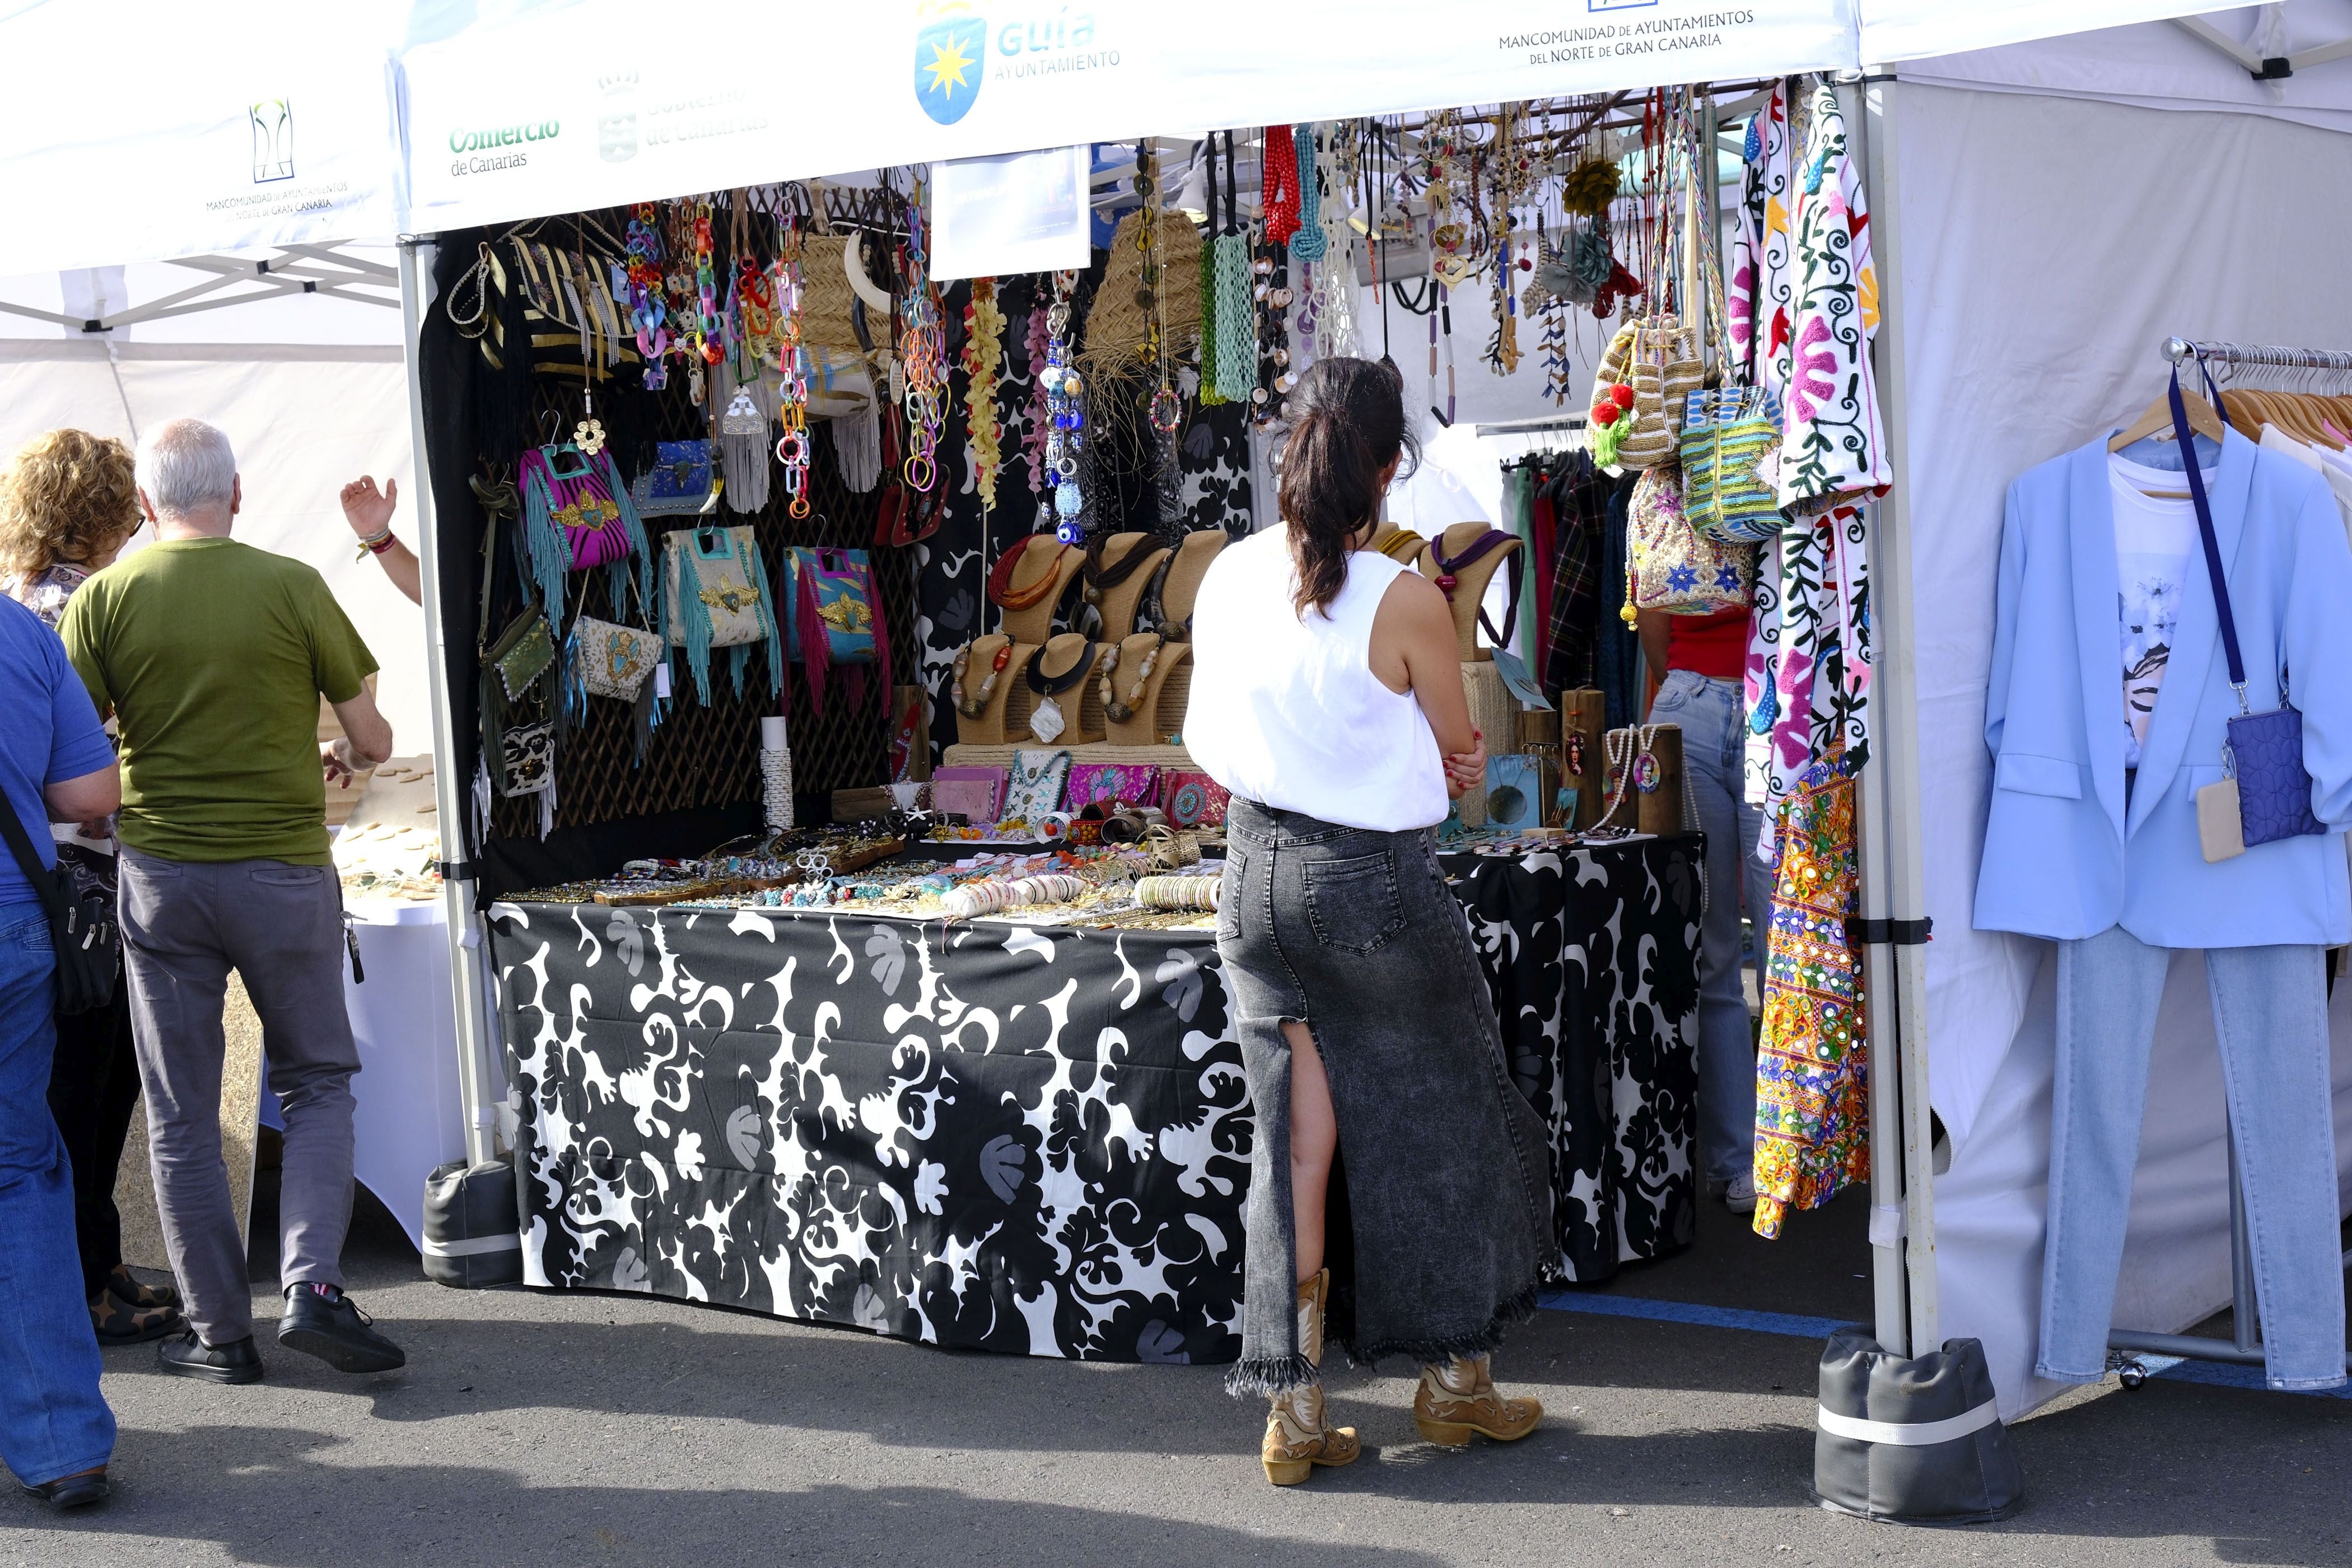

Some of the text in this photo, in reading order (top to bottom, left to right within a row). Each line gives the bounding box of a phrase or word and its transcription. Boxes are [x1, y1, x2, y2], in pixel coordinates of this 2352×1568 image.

[1499, 10, 1754, 49] MANCOMUNIDAD DE AYUNTAMIENTOS
[1530, 34, 1722, 65] DEL NORTE DE GRAN CANARIA
[995, 50, 1120, 81] AYUNTAMIENTO
[449, 119, 560, 153] Comercio
[451, 151, 528, 177] de Canarias
[206, 193, 273, 212] MANCOMUNIDAD
[282, 181, 348, 200] AYUNTAMIENTOS
[236, 208, 261, 221] NORTE
[271, 203, 293, 216] GRAN
[295, 198, 333, 212] CANARIA
